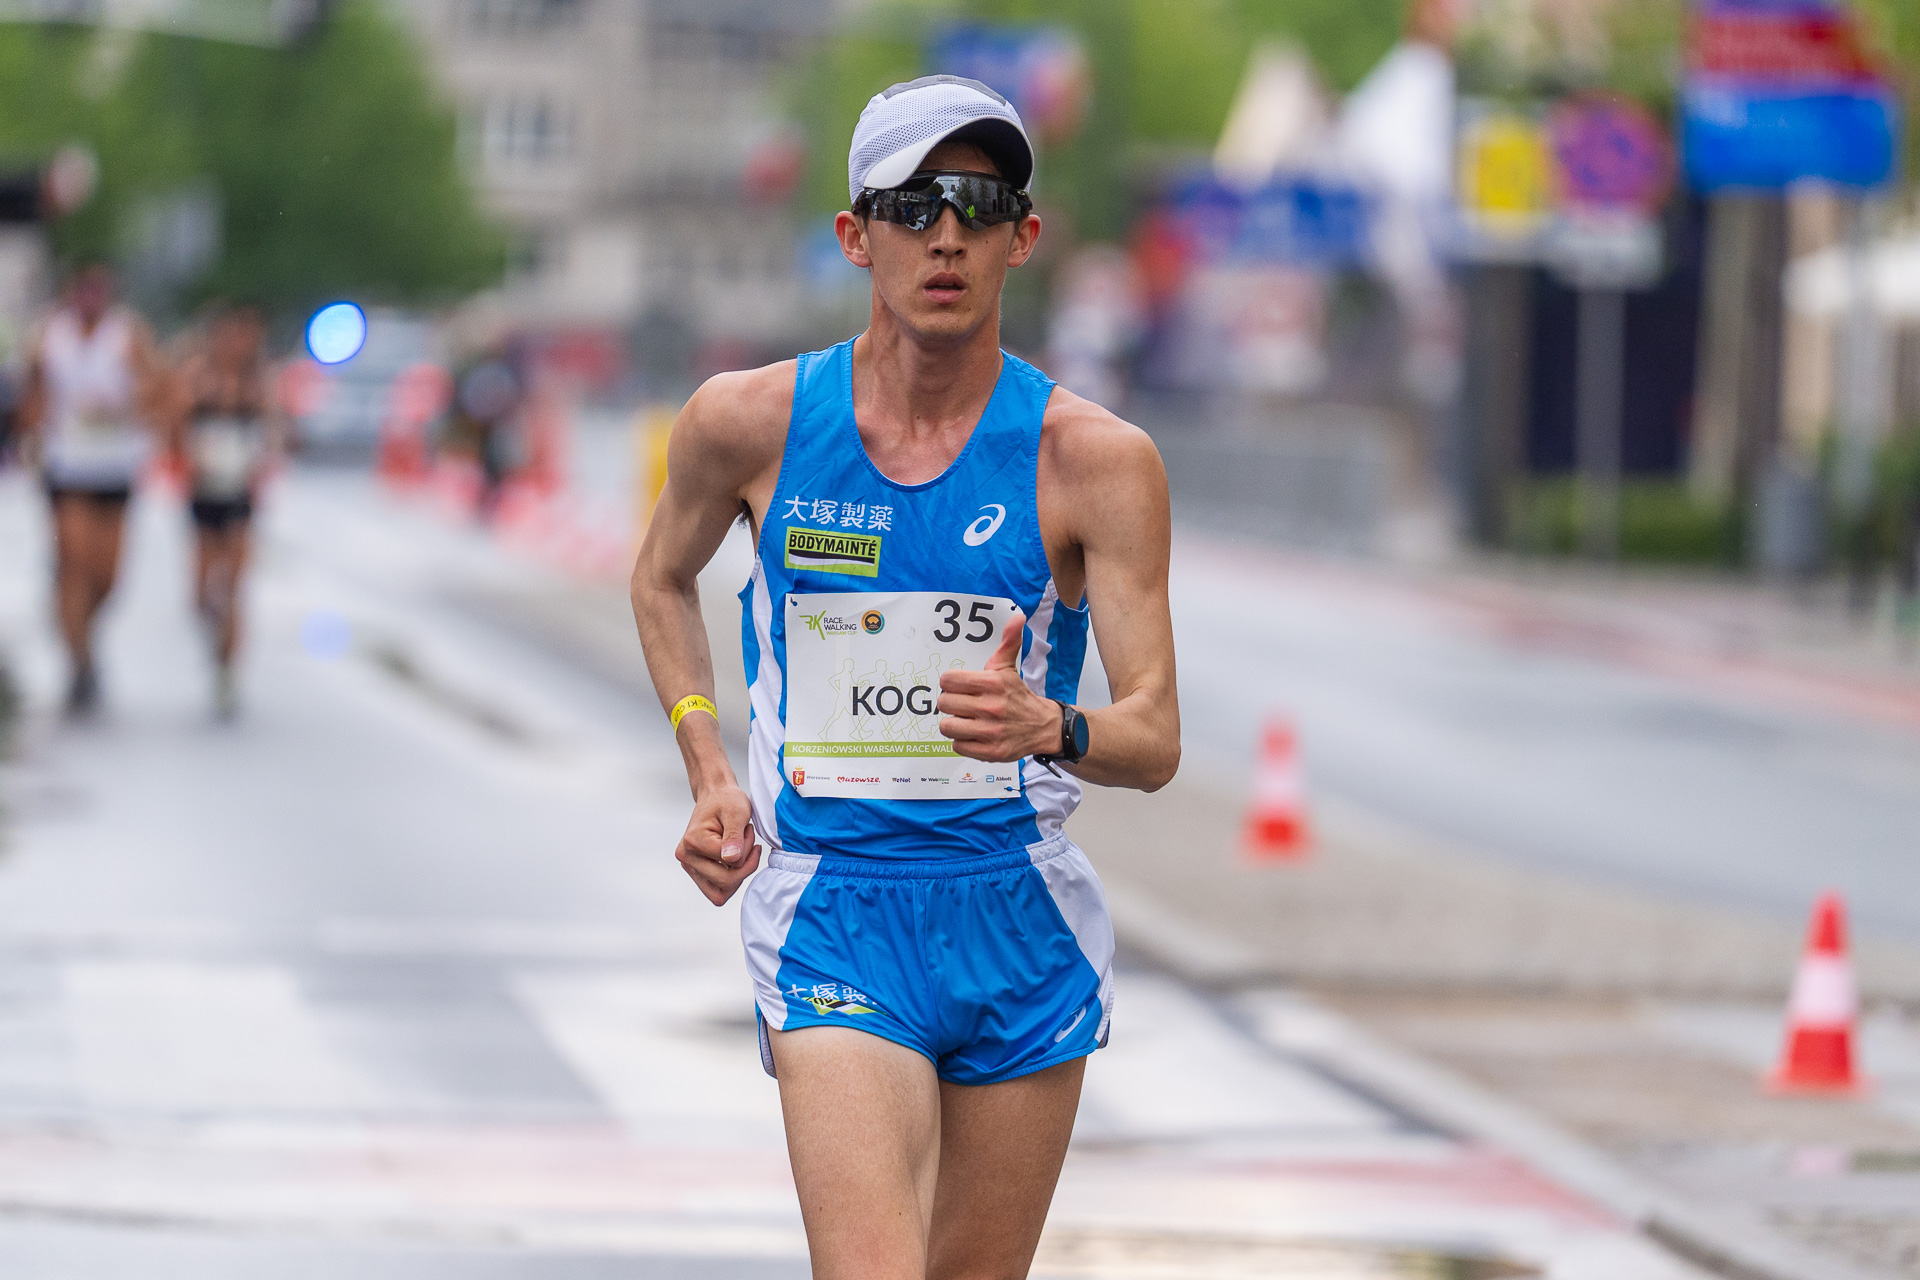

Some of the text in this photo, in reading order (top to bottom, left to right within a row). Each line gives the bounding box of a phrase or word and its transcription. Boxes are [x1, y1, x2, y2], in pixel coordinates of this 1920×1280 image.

[782, 495, 893, 531] 大塚製薬
[788, 534, 877, 557] BODYMAINTÉ
[933, 599, 995, 643] 35
[792, 744, 955, 753] KORZENIOWSKI WARSAW RACE WAL
